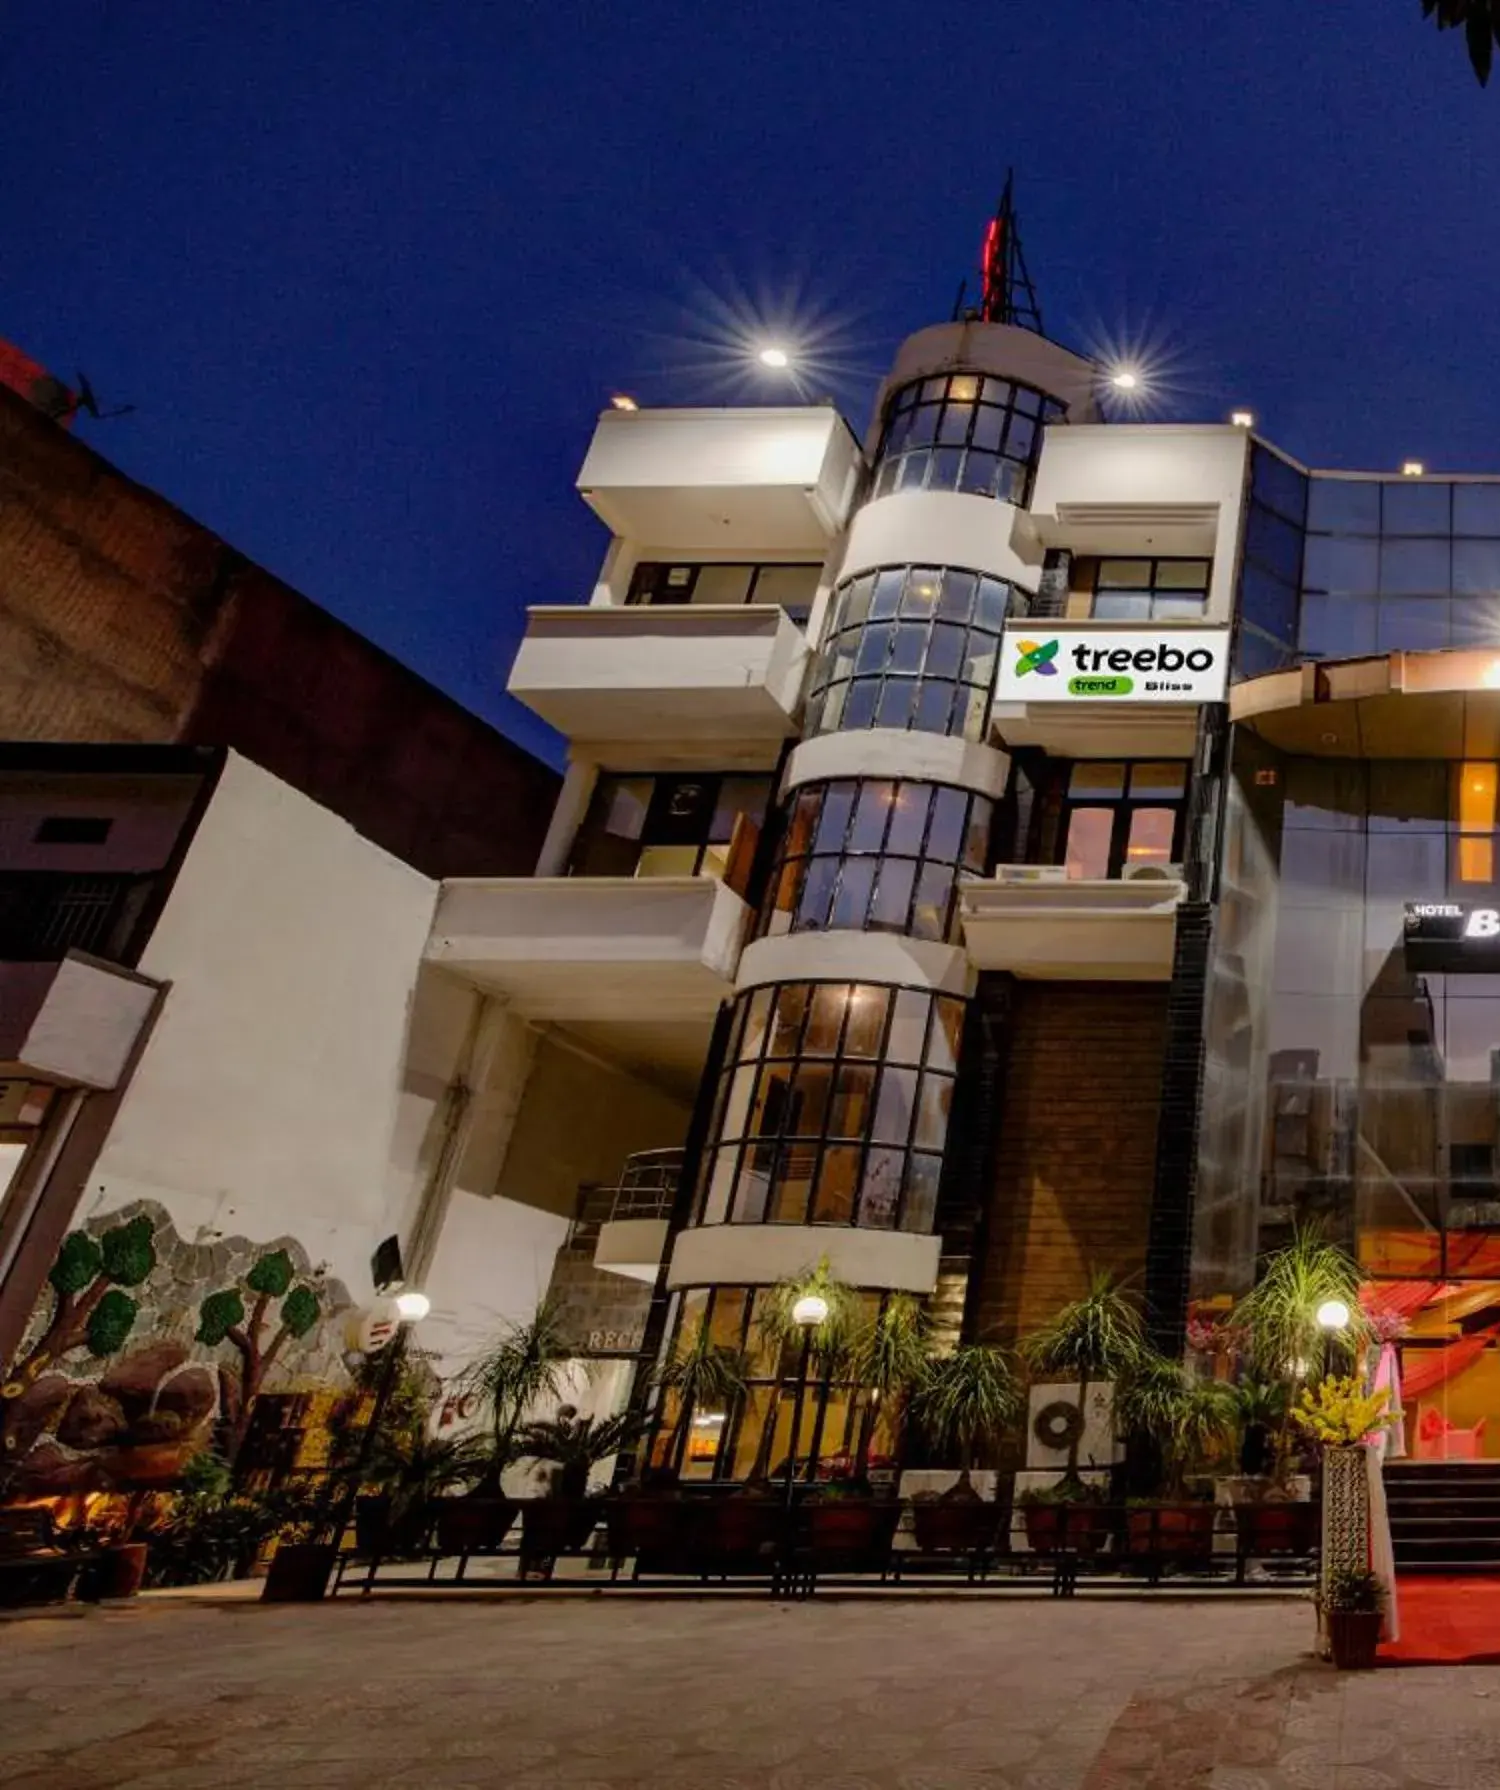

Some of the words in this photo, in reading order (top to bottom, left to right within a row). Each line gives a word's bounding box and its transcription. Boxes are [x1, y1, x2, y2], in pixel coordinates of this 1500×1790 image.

[1071, 643, 1214, 673] treebo
[1074, 678, 1117, 692] trend
[1414, 903, 1464, 917] HOTEL
